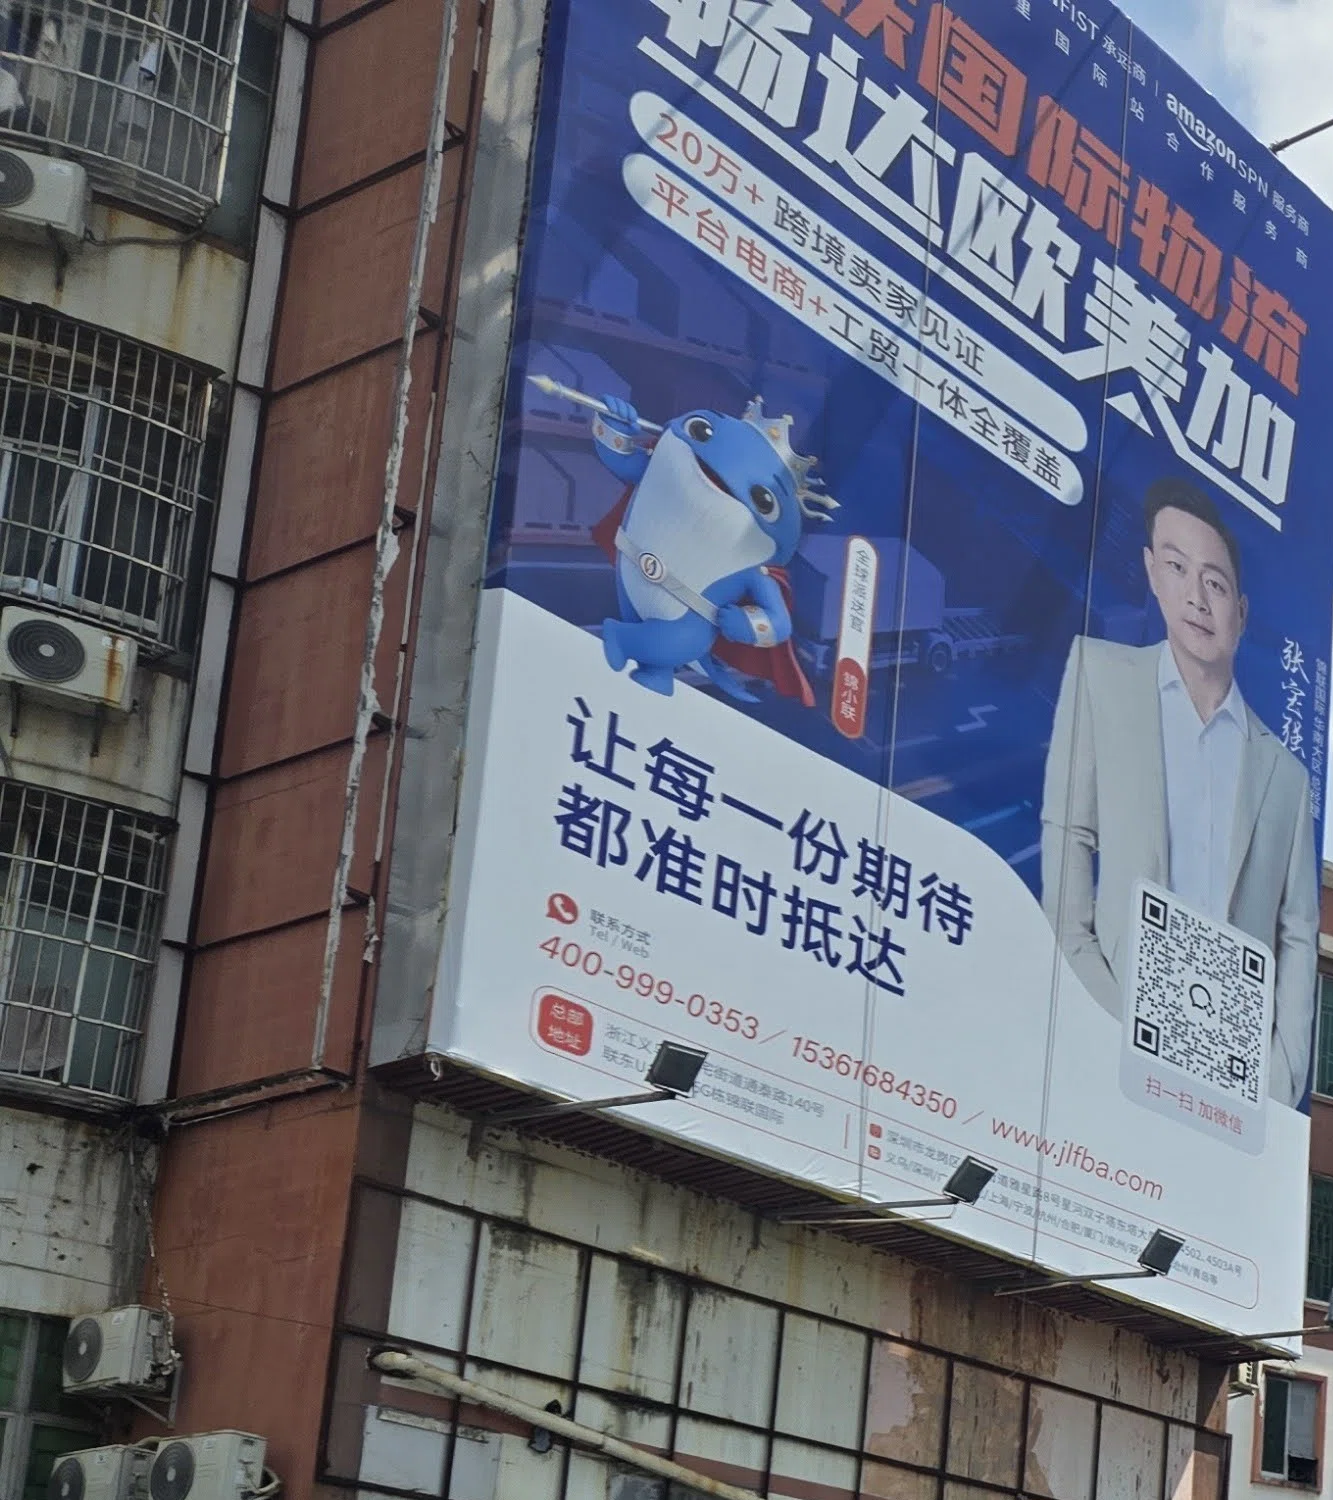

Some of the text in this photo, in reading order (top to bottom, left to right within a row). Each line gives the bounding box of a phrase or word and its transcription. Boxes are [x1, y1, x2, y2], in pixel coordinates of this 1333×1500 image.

[1103, 36, 1147, 87] 承运商
[1165, 92, 1237, 169] amazon
[1238, 155, 1269, 199] SPN
[1272, 190, 1310, 237] 服务商
[651, 174, 1061, 491] 平台电商+工贸一体全覆盖
[655, 112, 985, 376] 20万+ 跨境卖家见证
[554, 782, 906, 997] 都准时抵达
[566, 696, 975, 947] 让每一份期待
[549, 1002, 586, 1027] 总部
[589, 908, 651, 946] 联系方式
[539, 936, 760, 1041] 400-999-0353
[792, 1035, 957, 1121] 15361684350
[991, 1116, 1165, 1201] www.jlfba.com
[546, 1025, 584, 1051] 地址
[1145, 1073, 1244, 1136] 扫一扫 加微信
